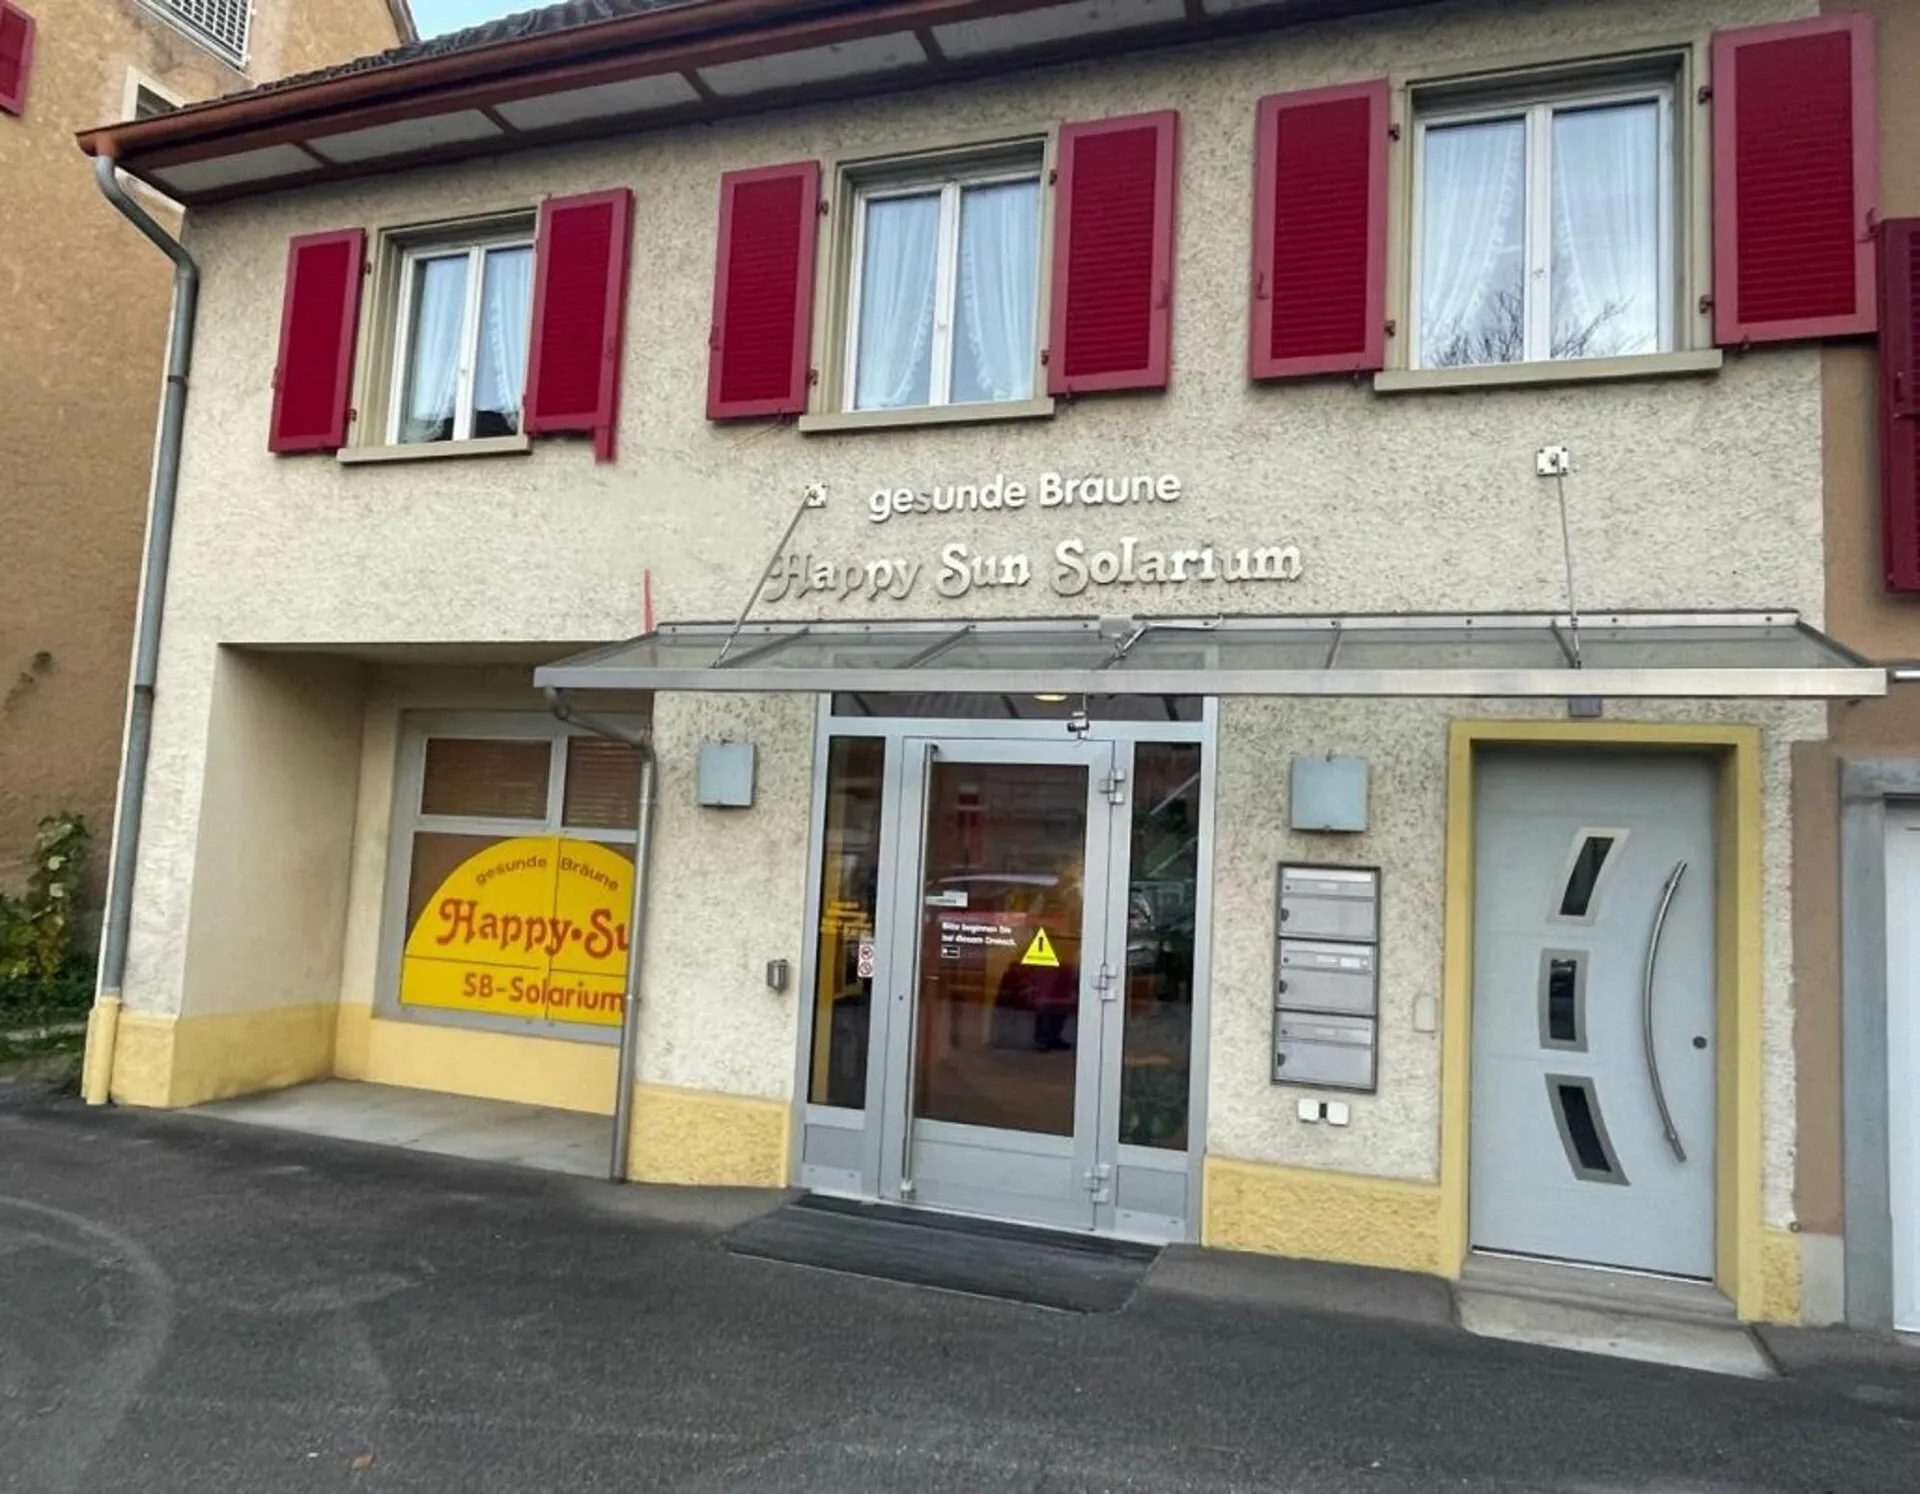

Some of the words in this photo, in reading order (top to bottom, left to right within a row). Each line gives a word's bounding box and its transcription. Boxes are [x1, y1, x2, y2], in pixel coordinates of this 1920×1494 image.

[868, 474, 1026, 523] gesunde
[760, 553, 923, 603] Happy
[935, 542, 1031, 597] Sun
[1050, 536, 1302, 596] Solarium
[475, 855, 548, 887] gesunde
[559, 856, 620, 891] Bräune
[462, 971, 626, 1014] SB-Solarium
